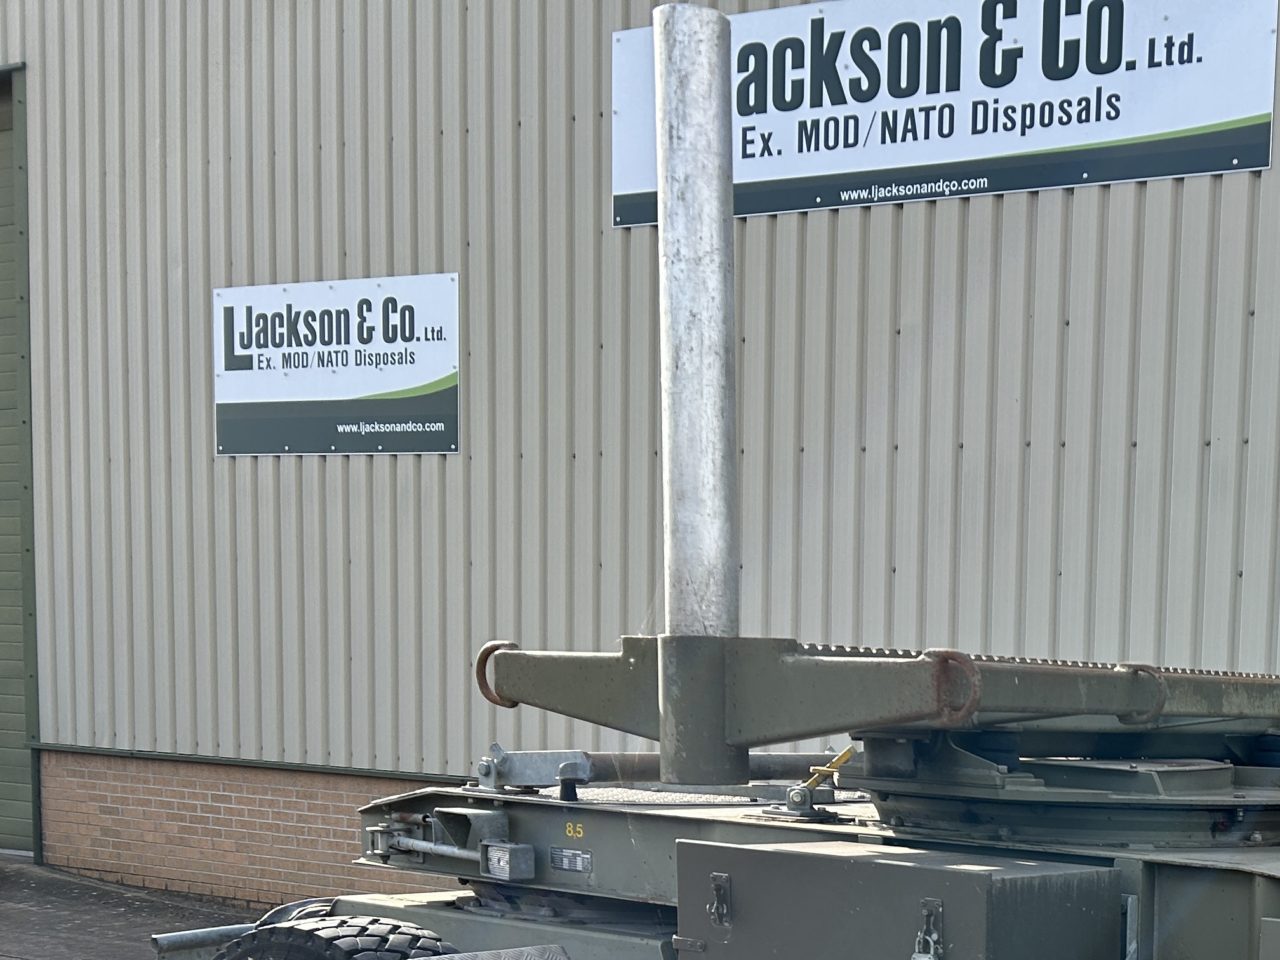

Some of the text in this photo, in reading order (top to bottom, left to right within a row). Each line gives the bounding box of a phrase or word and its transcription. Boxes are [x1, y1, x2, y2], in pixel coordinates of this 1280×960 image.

[736, 0, 1203, 117] ackson & Co. Ltd.
[741, 86, 1121, 160] Ex. MOD/NATO Disposals
[840, 177, 989, 202] www.ljacksonandco.com
[357, 298, 376, 345] &
[382, 296, 421, 344] Co.
[424, 326, 447, 342] Ltd.
[257, 347, 416, 370] Ex. MOD/NATO Disposals
[336, 420, 445, 436] www.ljacksonandco.com
